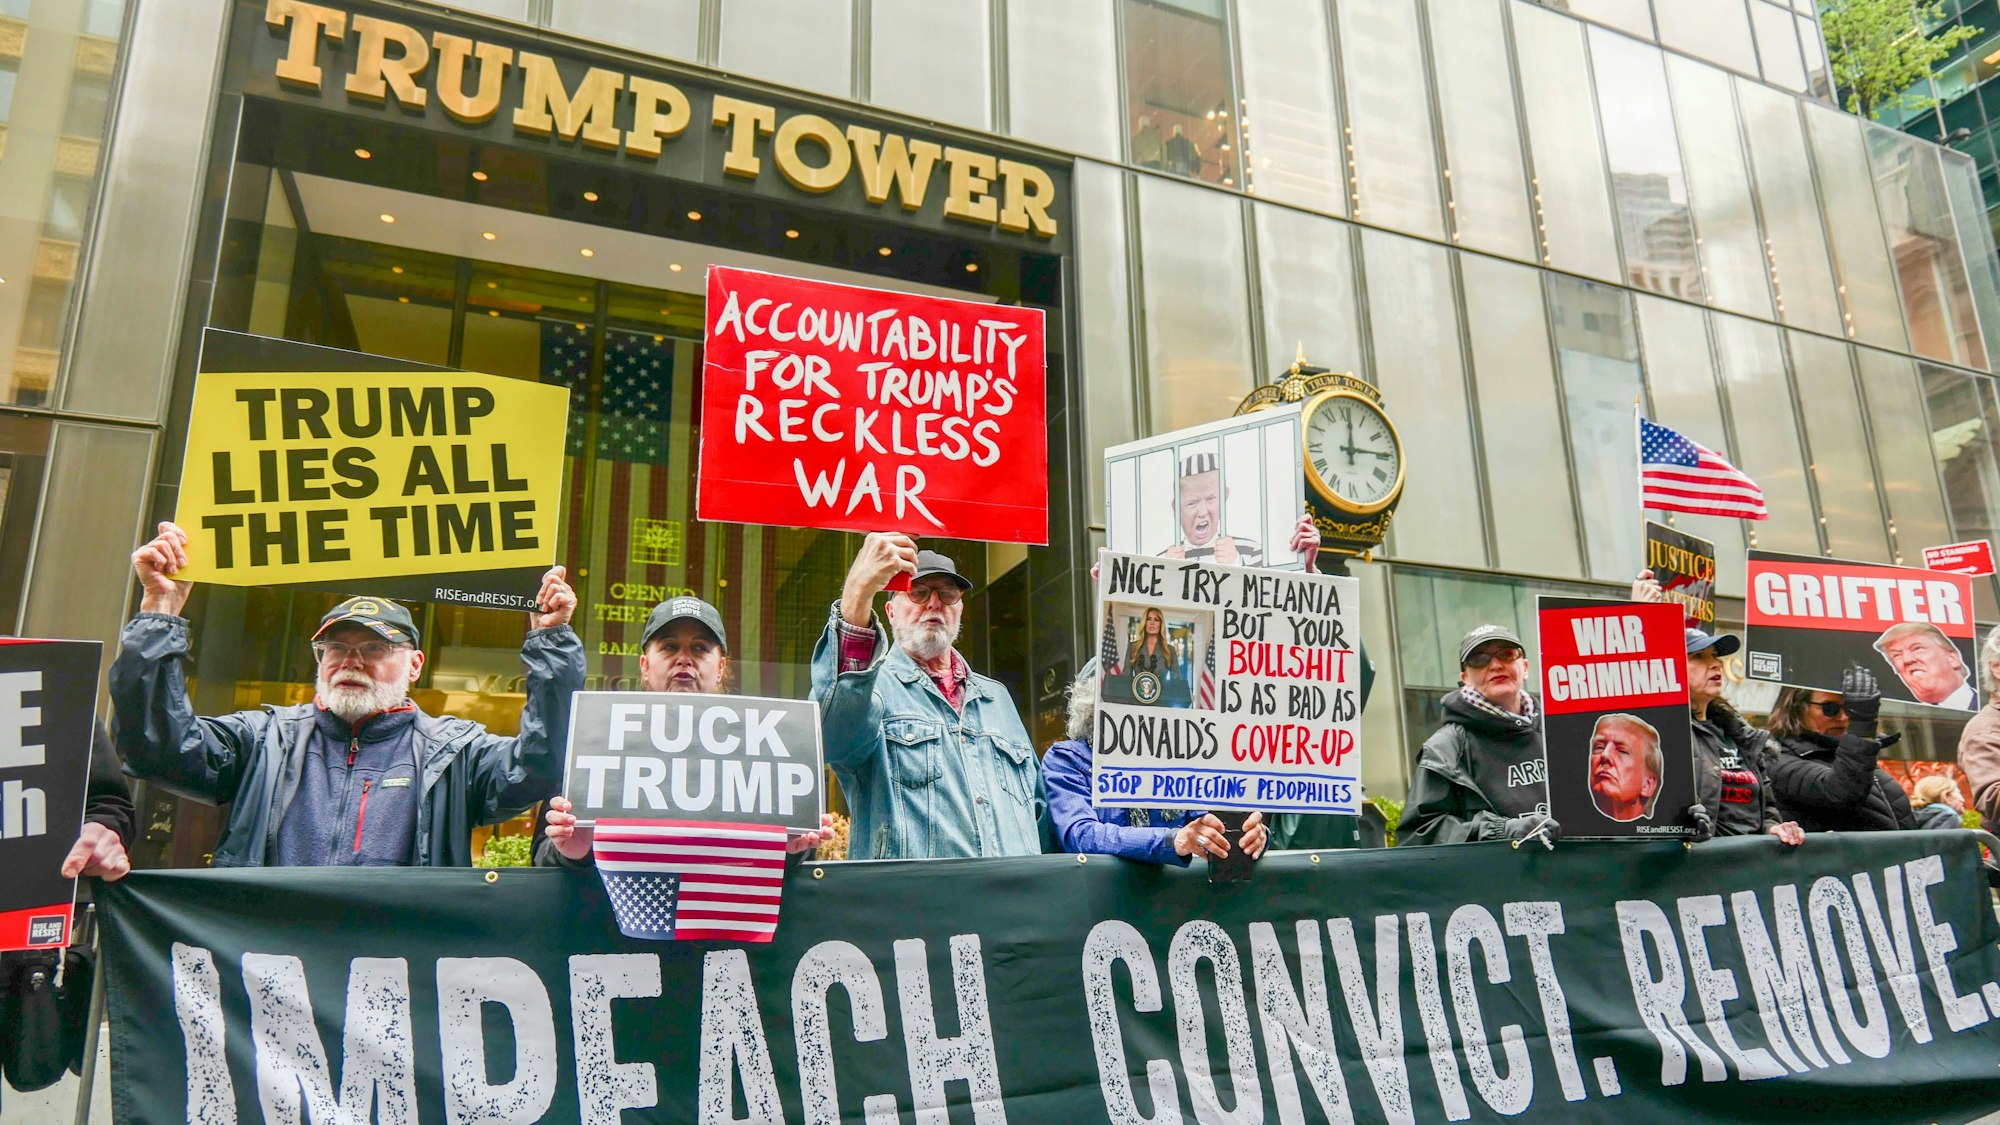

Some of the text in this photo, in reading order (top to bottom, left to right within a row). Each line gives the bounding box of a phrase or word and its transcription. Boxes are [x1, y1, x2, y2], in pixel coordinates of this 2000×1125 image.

[265, 0, 1058, 238] TRUMP TOWER
[715, 290, 1027, 381] ACCOUNTABILITY
[745, 350, 1018, 419] FOR TRUMP'S
[1308, 375, 1377, 399] TRUMP TOWER
[235, 386, 495, 441] TRUMP
[735, 394, 1001, 468] RECKLESS
[212, 443, 529, 505] LIES ALL
[793, 457, 946, 531] WAR
[201, 499, 539, 570] THE TIME
[1926, 545, 1980, 559] NO STANDING
[1648, 538, 1714, 583] JUSTICE
[1929, 556, 1963, 566] Anytime
[435, 587, 543, 611] RISEandRESIST.or
[610, 583, 667, 602] OPEN
[1108, 556, 1341, 616] NICE TRY, MELANIA
[1753, 571, 1965, 625] GRIFTER
[594, 603, 635, 623] THE
[1222, 608, 1350, 650] BUT YOUR
[1571, 614, 1646, 657] WAR
[1228, 639, 1354, 684] BULLSHIT
[1548, 658, 1682, 702] CRIMINAL
[1753, 664, 1778, 673] RESIST
[1220, 679, 1356, 723] IS AS BAD AS
[608, 703, 791, 758] FUCK
[1098, 710, 1219, 760] DONALD'S
[1231, 723, 1354, 767] COVER-UP
[575, 755, 814, 816] TRUMP
[1098, 771, 1352, 803] STOP PROTECTING PEDOPHILES
[1636, 825, 1697, 836] RISEandRESIST.org
[32, 929, 61, 938] RESIST
[33, 922, 62, 930] RISE AND
[171, 933, 1006, 1125] IMPEACH
[1081, 901, 1622, 1125] CONVICT.
